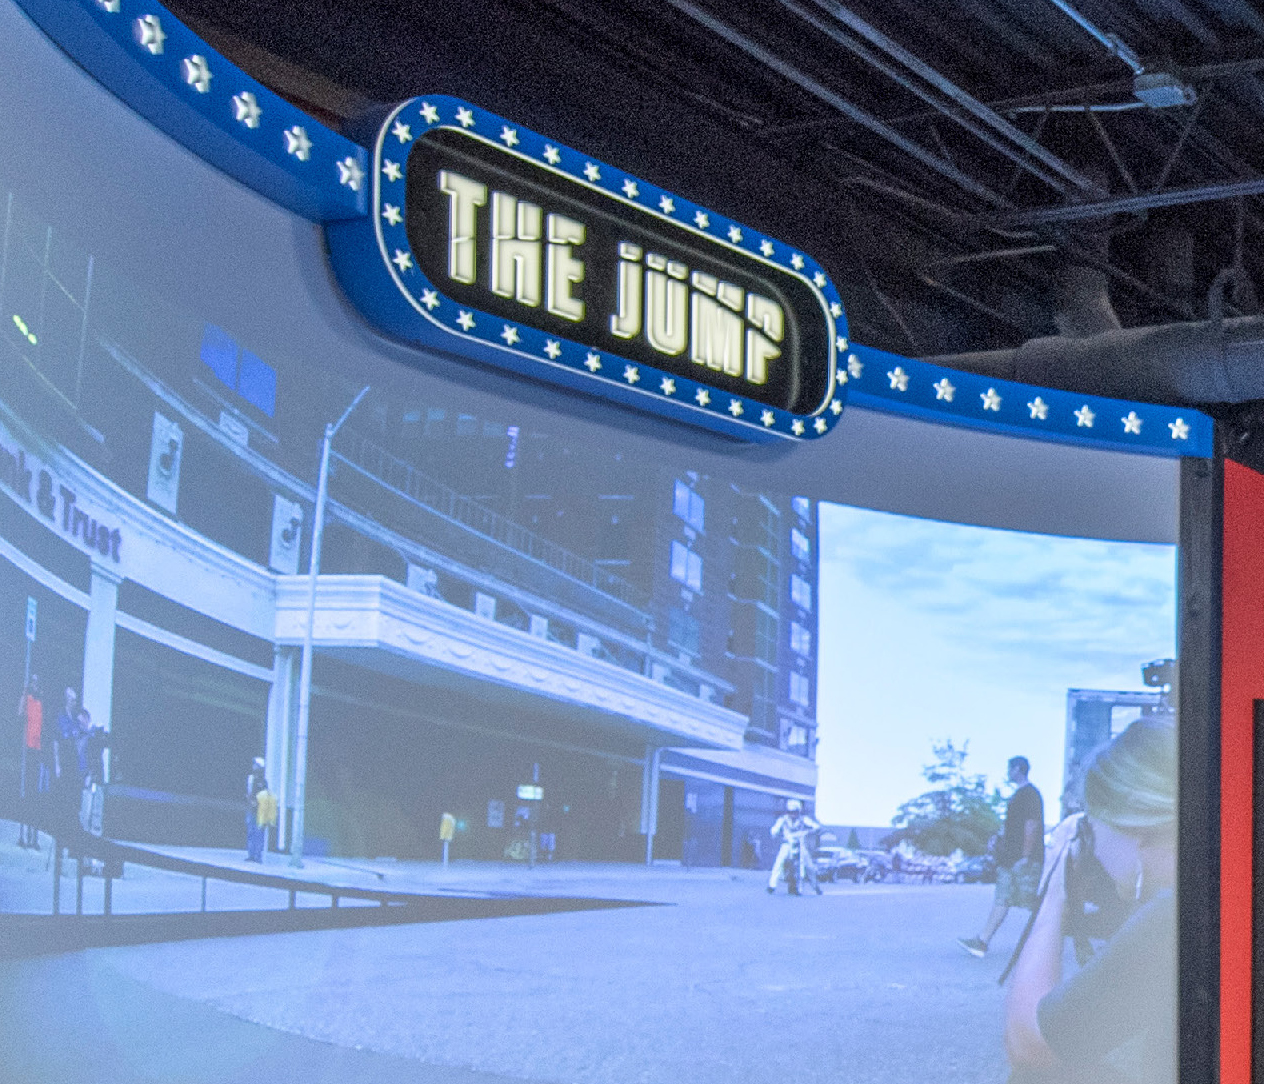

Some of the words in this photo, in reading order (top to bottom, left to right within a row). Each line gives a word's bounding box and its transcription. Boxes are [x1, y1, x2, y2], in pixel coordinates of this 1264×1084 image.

[438, 169, 588, 323] THE
[609, 240, 785, 386] JUMP
[36, 469, 56, 523] &
[60, 483, 122, 564] Trust
